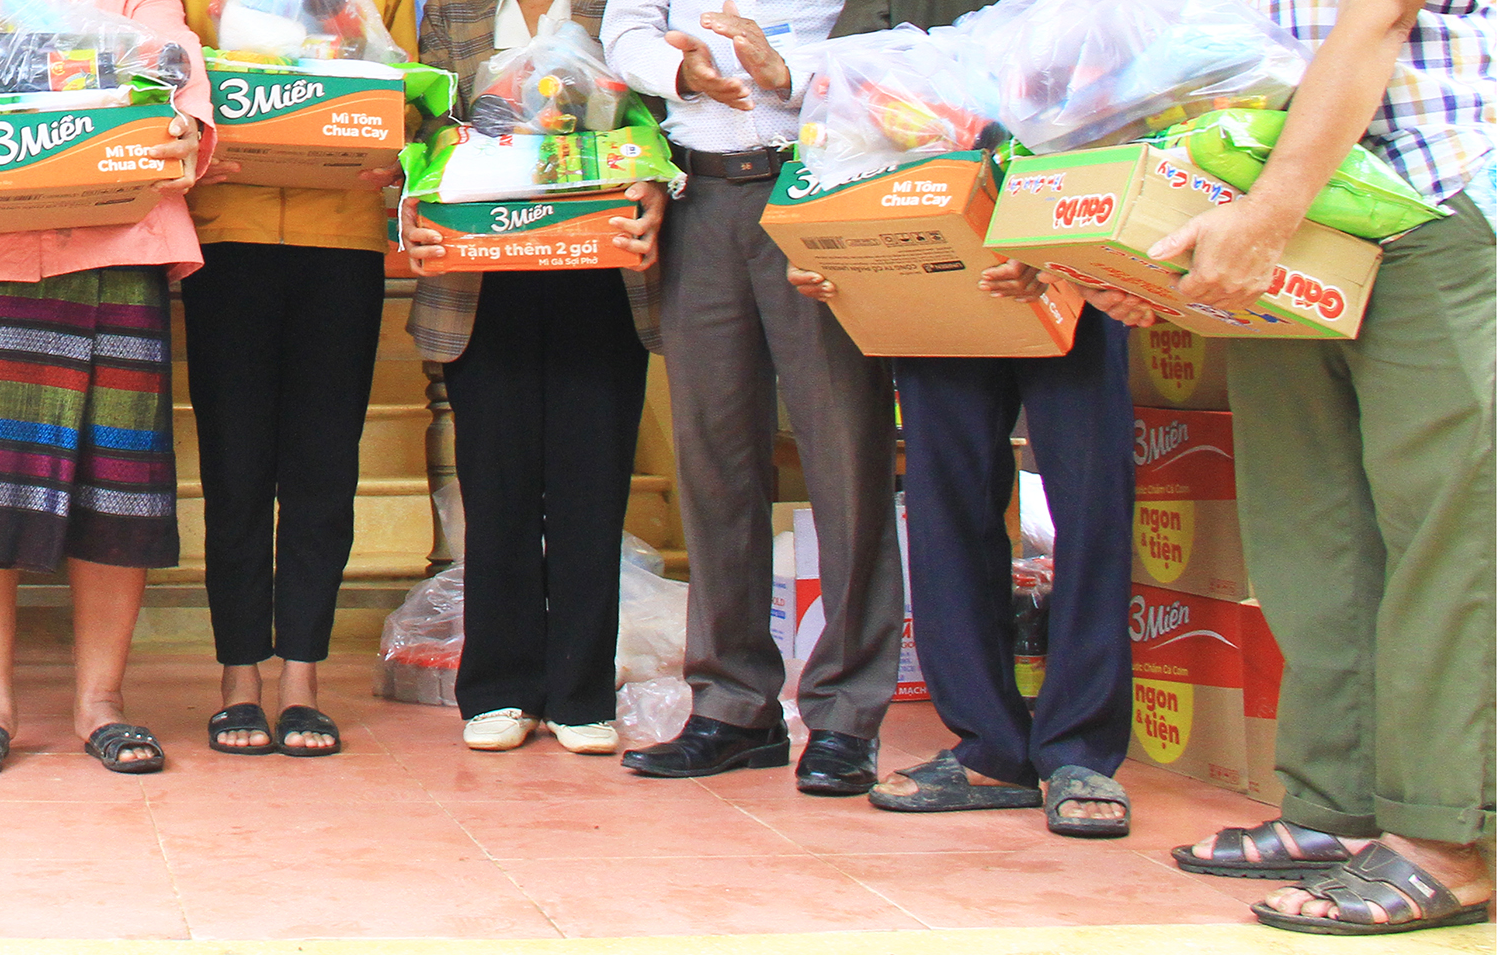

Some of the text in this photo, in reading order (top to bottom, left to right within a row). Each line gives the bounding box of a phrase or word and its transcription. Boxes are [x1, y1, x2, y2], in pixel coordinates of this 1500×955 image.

[332, 112, 382, 125] Mì Tôm
[323, 125, 388, 140] Chua Cay
[105, 145, 124, 158] Mì
[98, 158, 165, 172] Chua Cay
[1158, 161, 1187, 187] Cay
[892, 180, 947, 193] Mì Tôm
[881, 194, 951, 207] Chua Cay
[458, 240, 598, 260] Tặng thêm 2 gói
[1150, 328, 1192, 354] ngon
[1160, 354, 1194, 388] tiện
[1140, 507, 1181, 533] ngon
[1150, 534, 1182, 569] tiện
[1135, 682, 1178, 712] ngon
[1145, 712, 1180, 750] tiện
